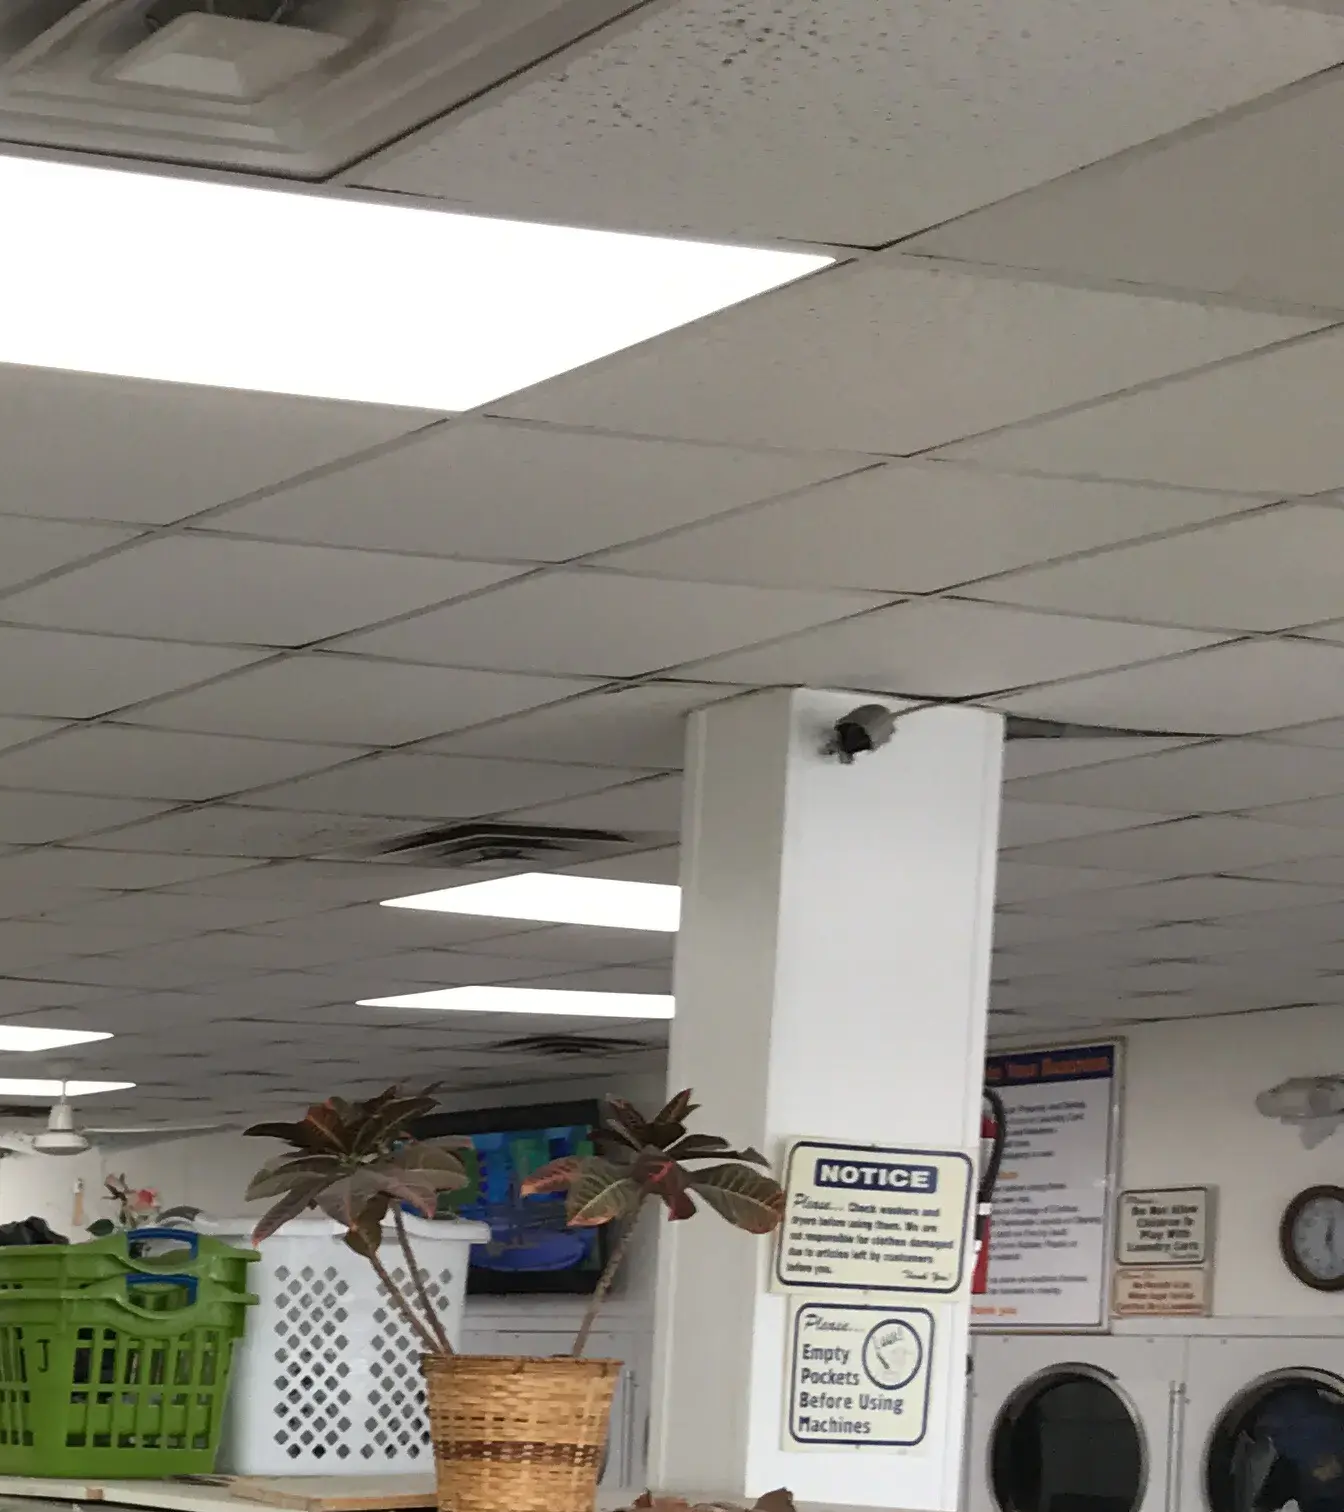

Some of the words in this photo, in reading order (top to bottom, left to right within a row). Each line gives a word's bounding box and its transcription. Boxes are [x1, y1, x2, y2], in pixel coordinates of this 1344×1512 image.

[820, 1164, 931, 1188] NOTICE
[848, 1202, 877, 1214] Check
[880, 1206, 919, 1217] washers
[922, 1207, 941, 1217] and
[819, 1216, 846, 1227] before
[848, 1218, 873, 1231] using
[922, 1224, 938, 1233] are
[790, 1231, 803, 1241] not
[805, 1232, 853, 1244] responsible
[856, 1234, 869, 1245] for
[872, 1236, 906, 1247] clothes
[910, 1238, 954, 1250] damaged
[788, 1247, 802, 1257] due
[805, 1248, 814, 1258] to
[816, 1249, 849, 1260] articles
[852, 1250, 866, 1261] left
[869, 1252, 881, 1263] by
[883, 1253, 934, 1264] customers
[786, 1262, 812, 1273] before
[802, 1343, 850, 1365] Empty
[800, 1367, 860, 1386] Pockets
[799, 1391, 853, 1410] Before
[859, 1393, 904, 1415] Using
[798, 1416, 871, 1434] Machines
